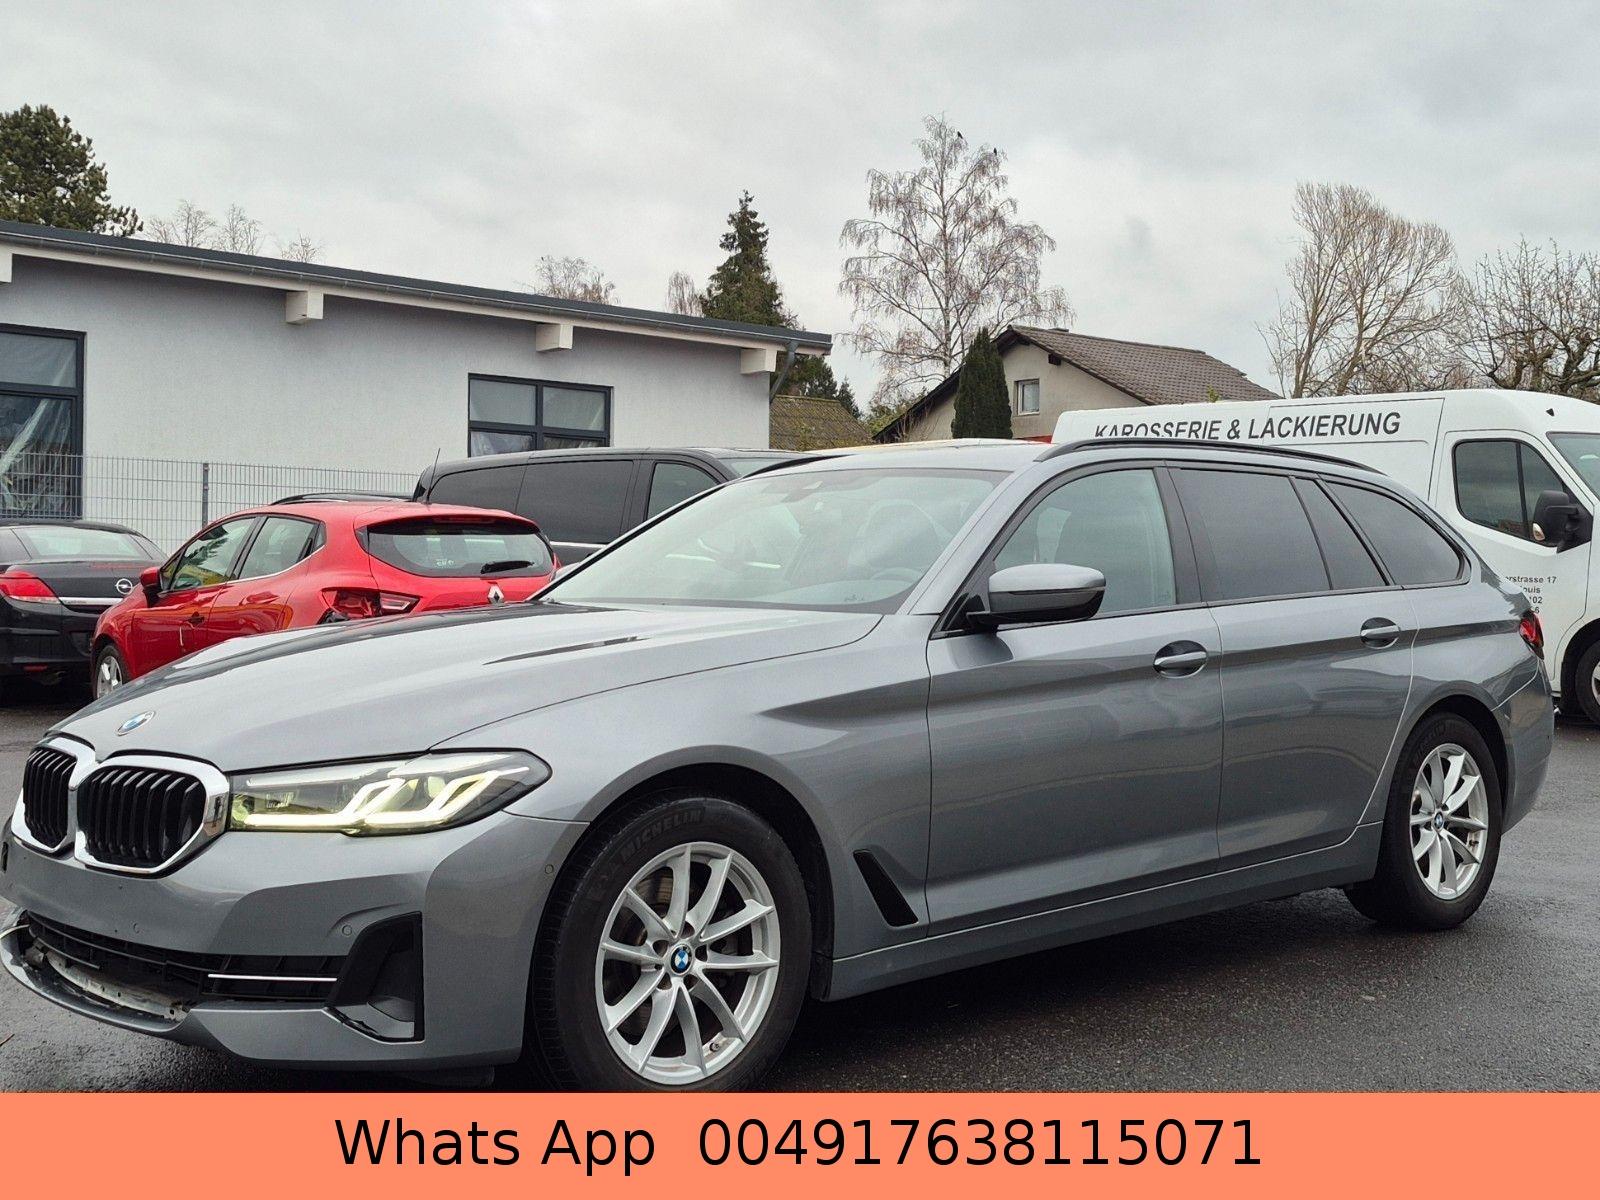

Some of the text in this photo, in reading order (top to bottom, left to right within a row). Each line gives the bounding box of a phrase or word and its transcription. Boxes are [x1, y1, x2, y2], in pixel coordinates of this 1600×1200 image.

[1226, 418, 1241, 440] &
[1248, 411, 1402, 439] LACKIERUNG
[1547, 576, 1557, 584] 17
[1521, 586, 1541, 594] ouis
